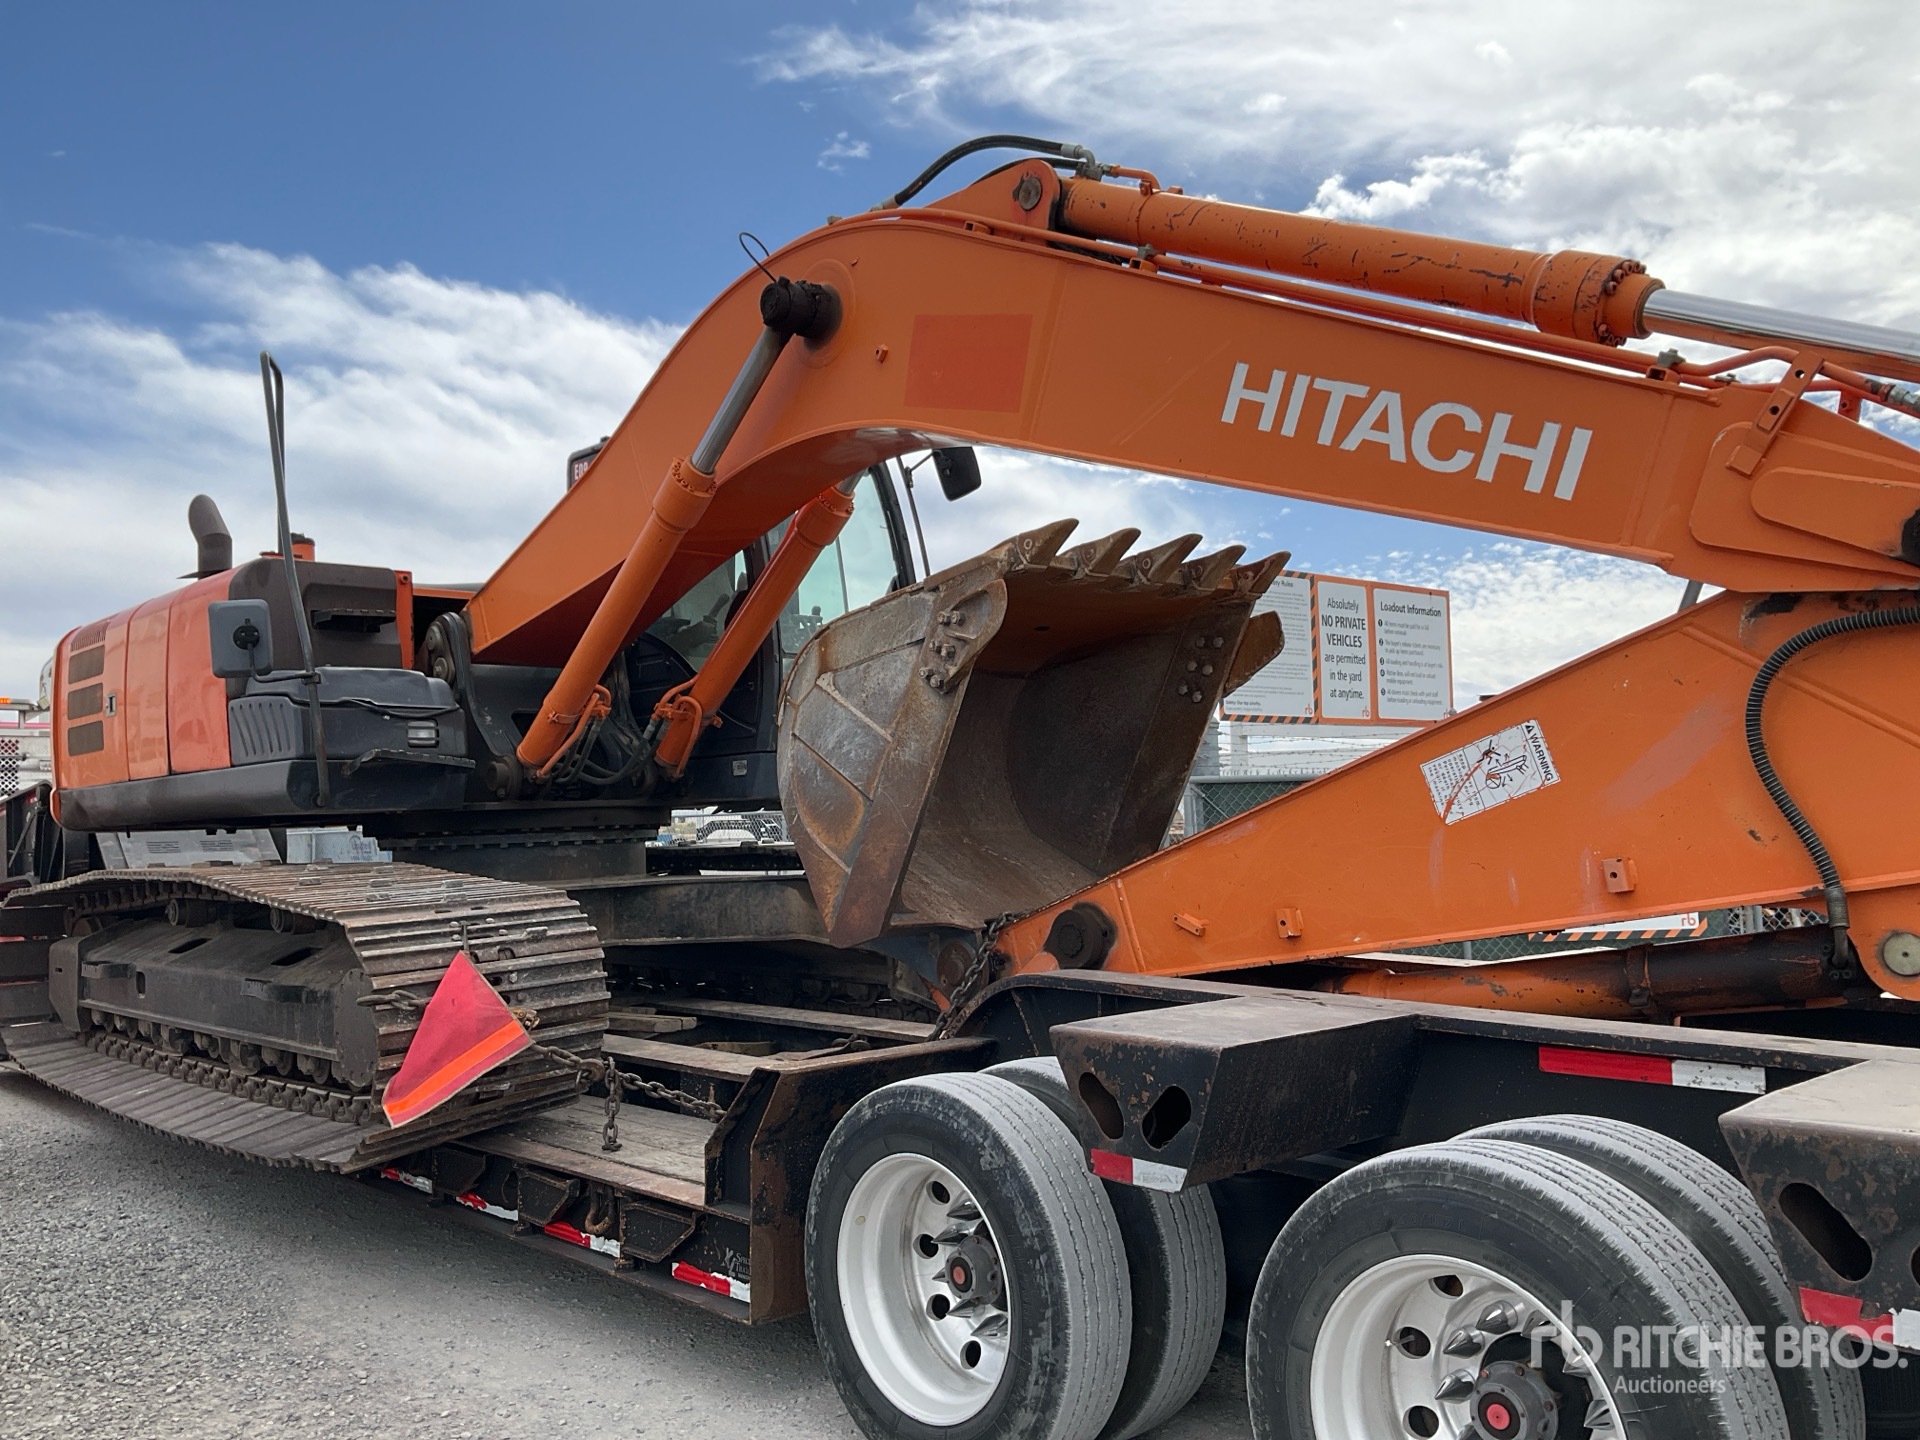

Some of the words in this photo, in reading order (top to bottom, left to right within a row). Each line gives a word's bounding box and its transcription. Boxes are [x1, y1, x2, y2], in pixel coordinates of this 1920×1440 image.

[1221, 361, 1593, 500] HITACHI
[1327, 597, 1359, 613] Absolutely
[1380, 601, 1406, 613] Loadout
[1407, 604, 1441, 617] Information
[1321, 614, 1333, 627] NO
[1335, 616, 1366, 631] PRIVATE
[1326, 633, 1362, 648] VEHICLES
[1324, 653, 1335, 663] are
[1336, 653, 1366, 666] permitted
[1329, 669, 1335, 680] in
[1337, 670, 1347, 681] the
[1348, 670, 1362, 684] yard
[1329, 689, 1337, 698] at
[1337, 688, 1364, 701] anytime.
[1304, 704, 1313, 715] rb
[1362, 706, 1370, 717] rb
[1456, 753, 1467, 769] Keep
[1529, 733, 1554, 782] WARNING
[1681, 913, 1696, 926] rb
